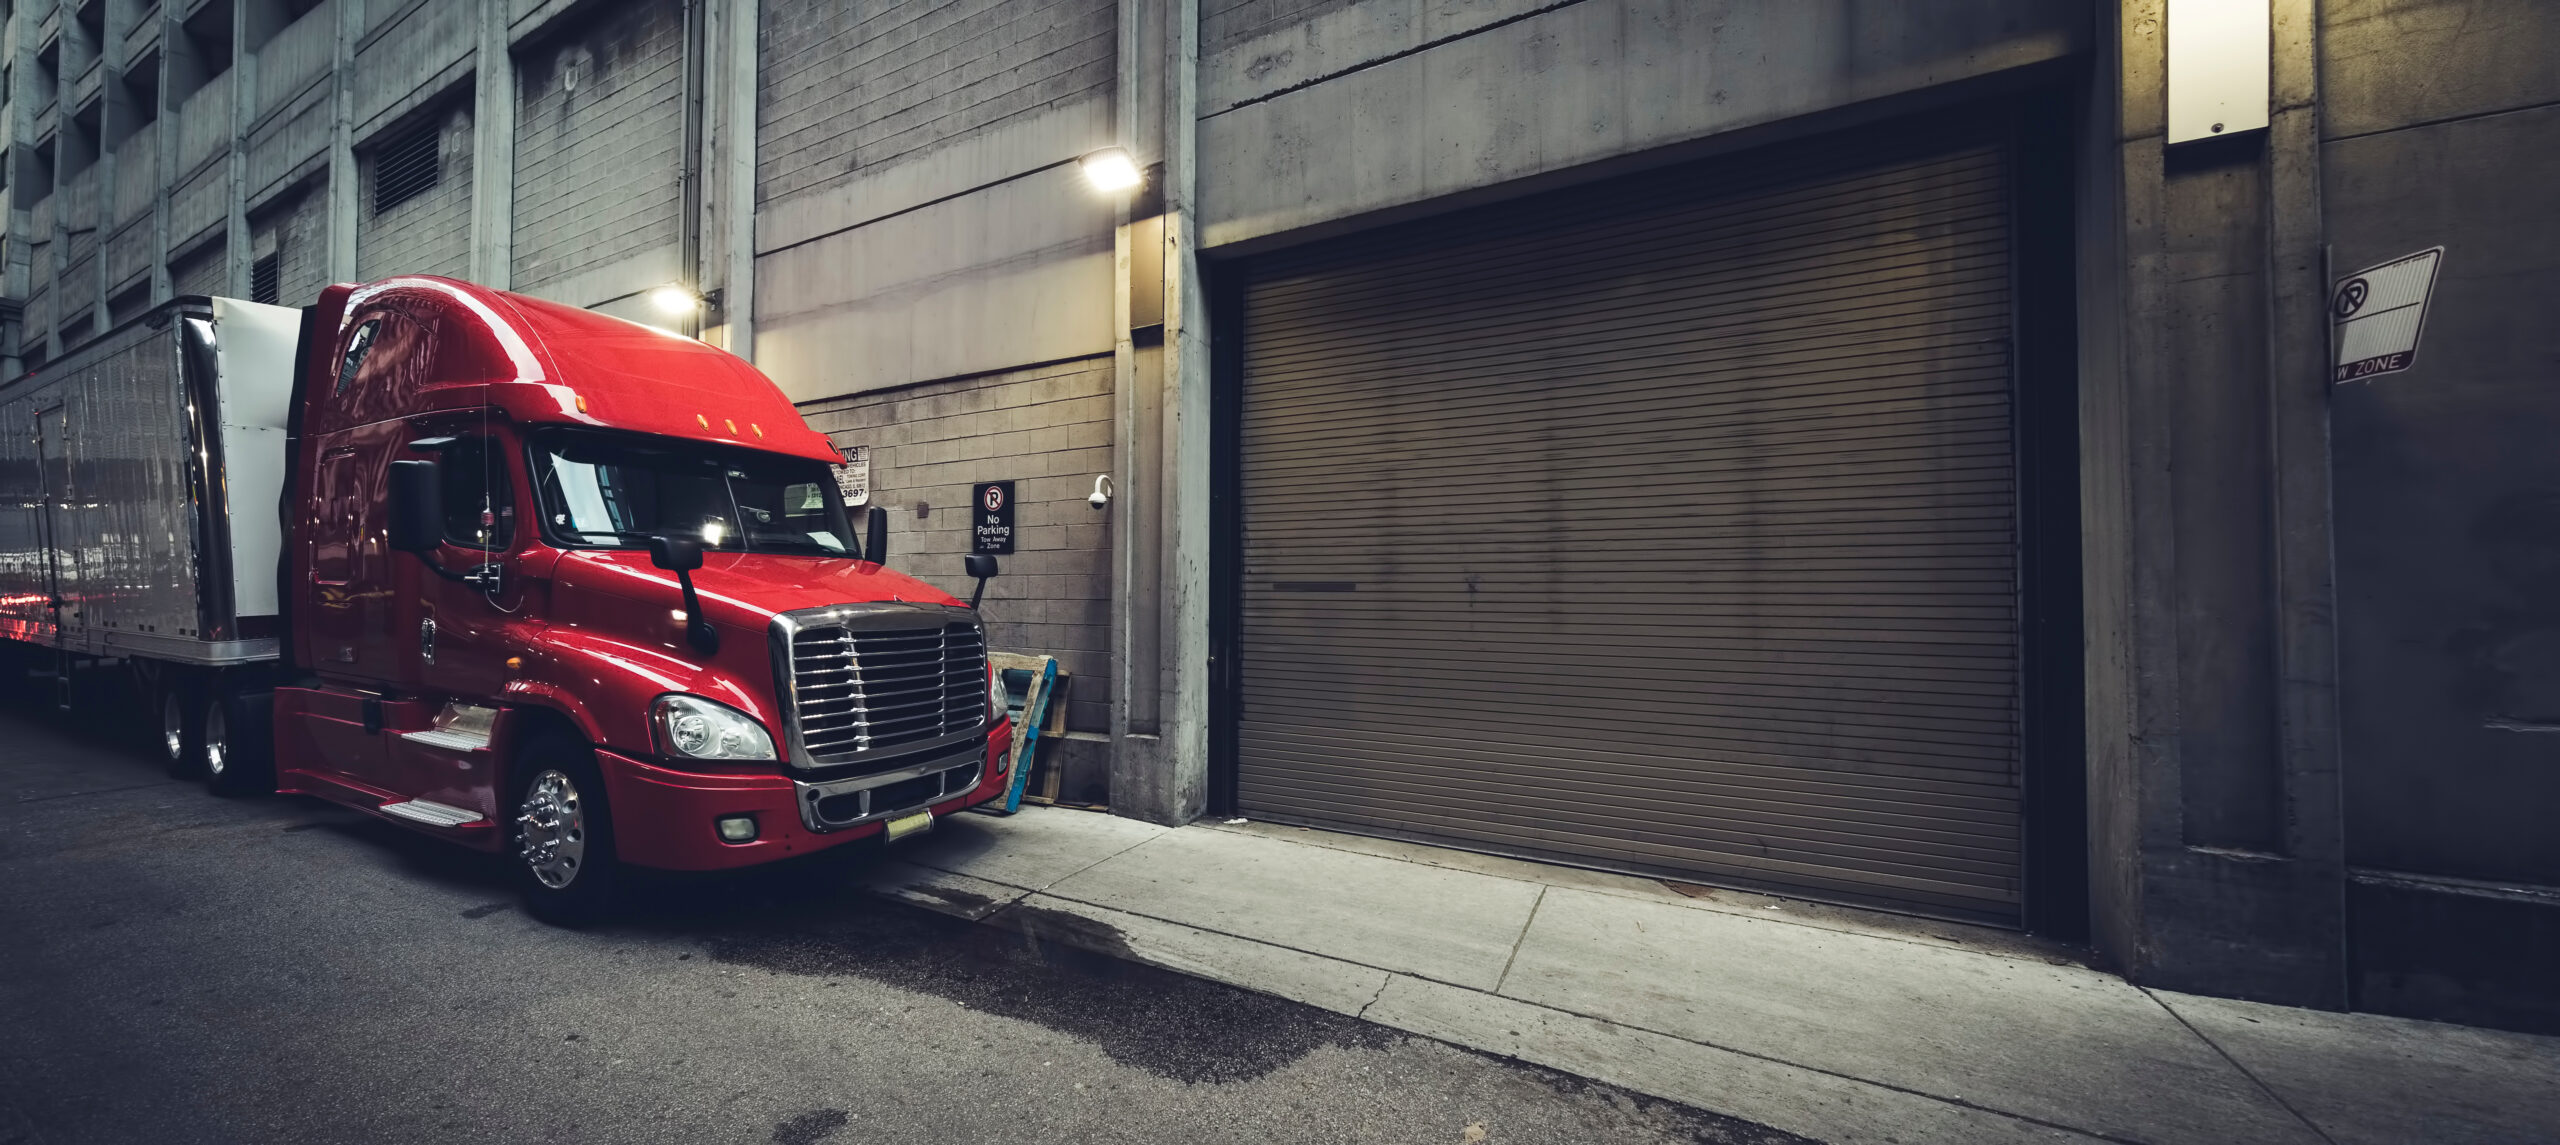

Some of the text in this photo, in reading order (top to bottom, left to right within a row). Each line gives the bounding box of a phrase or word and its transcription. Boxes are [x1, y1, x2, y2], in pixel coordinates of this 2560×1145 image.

[2355, 354, 2402, 376] ZONE
[843, 489, 864, 497] 3697
[987, 515, 1000, 524] No
[977, 525, 1010, 536] Parking
